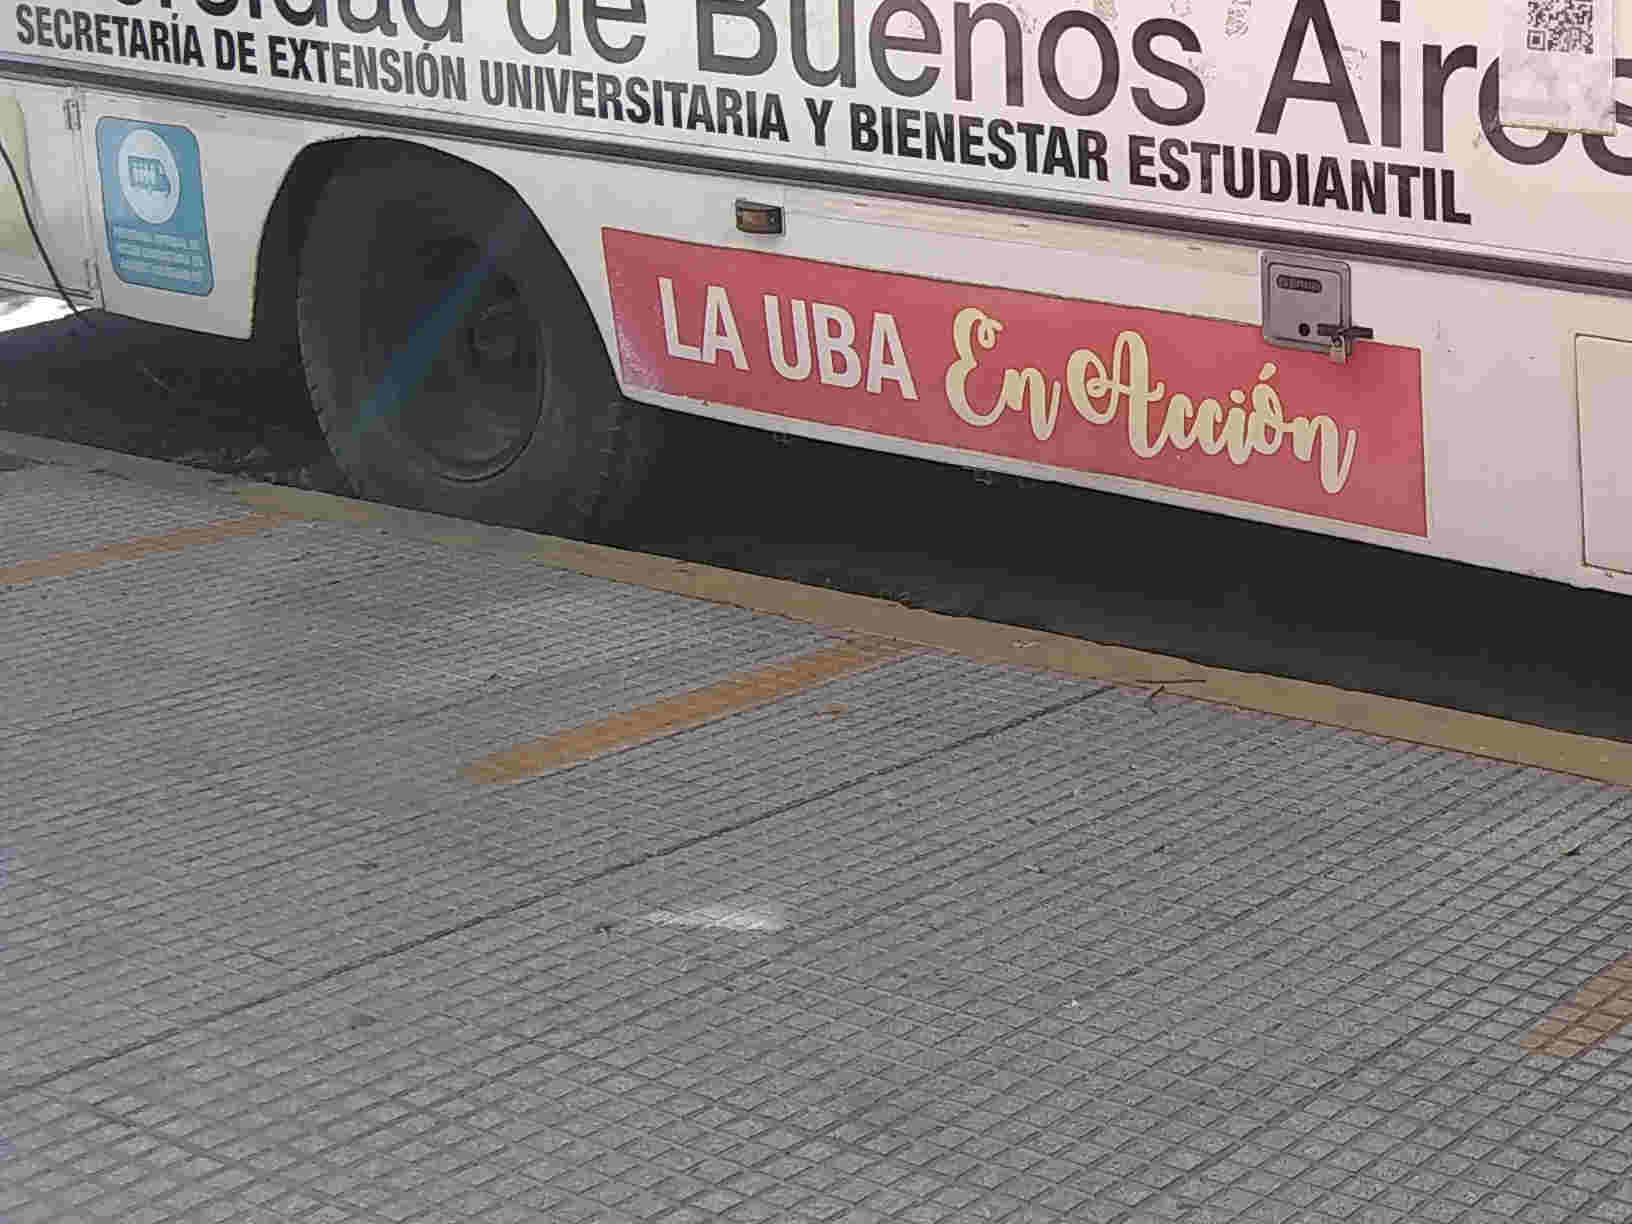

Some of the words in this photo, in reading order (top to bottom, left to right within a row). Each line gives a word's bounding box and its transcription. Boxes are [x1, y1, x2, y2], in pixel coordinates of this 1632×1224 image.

[16, 3, 206, 68] SECRETARÍA
[214, 27, 258, 73] DE
[268, 34, 467, 101] EXTENSIÓN
[480, 59, 790, 142] UNIVERSITARIA
[804, 97, 833, 146] Y
[850, 102, 1110, 182] BIENESTAR
[1127, 135, 1472, 225] ESTUDIANTIL
[657, 277, 748, 374] LA
[764, 294, 919, 401] UBA
[945, 307, 1060, 441] En
[1066, 330, 1357, 494] Acción
